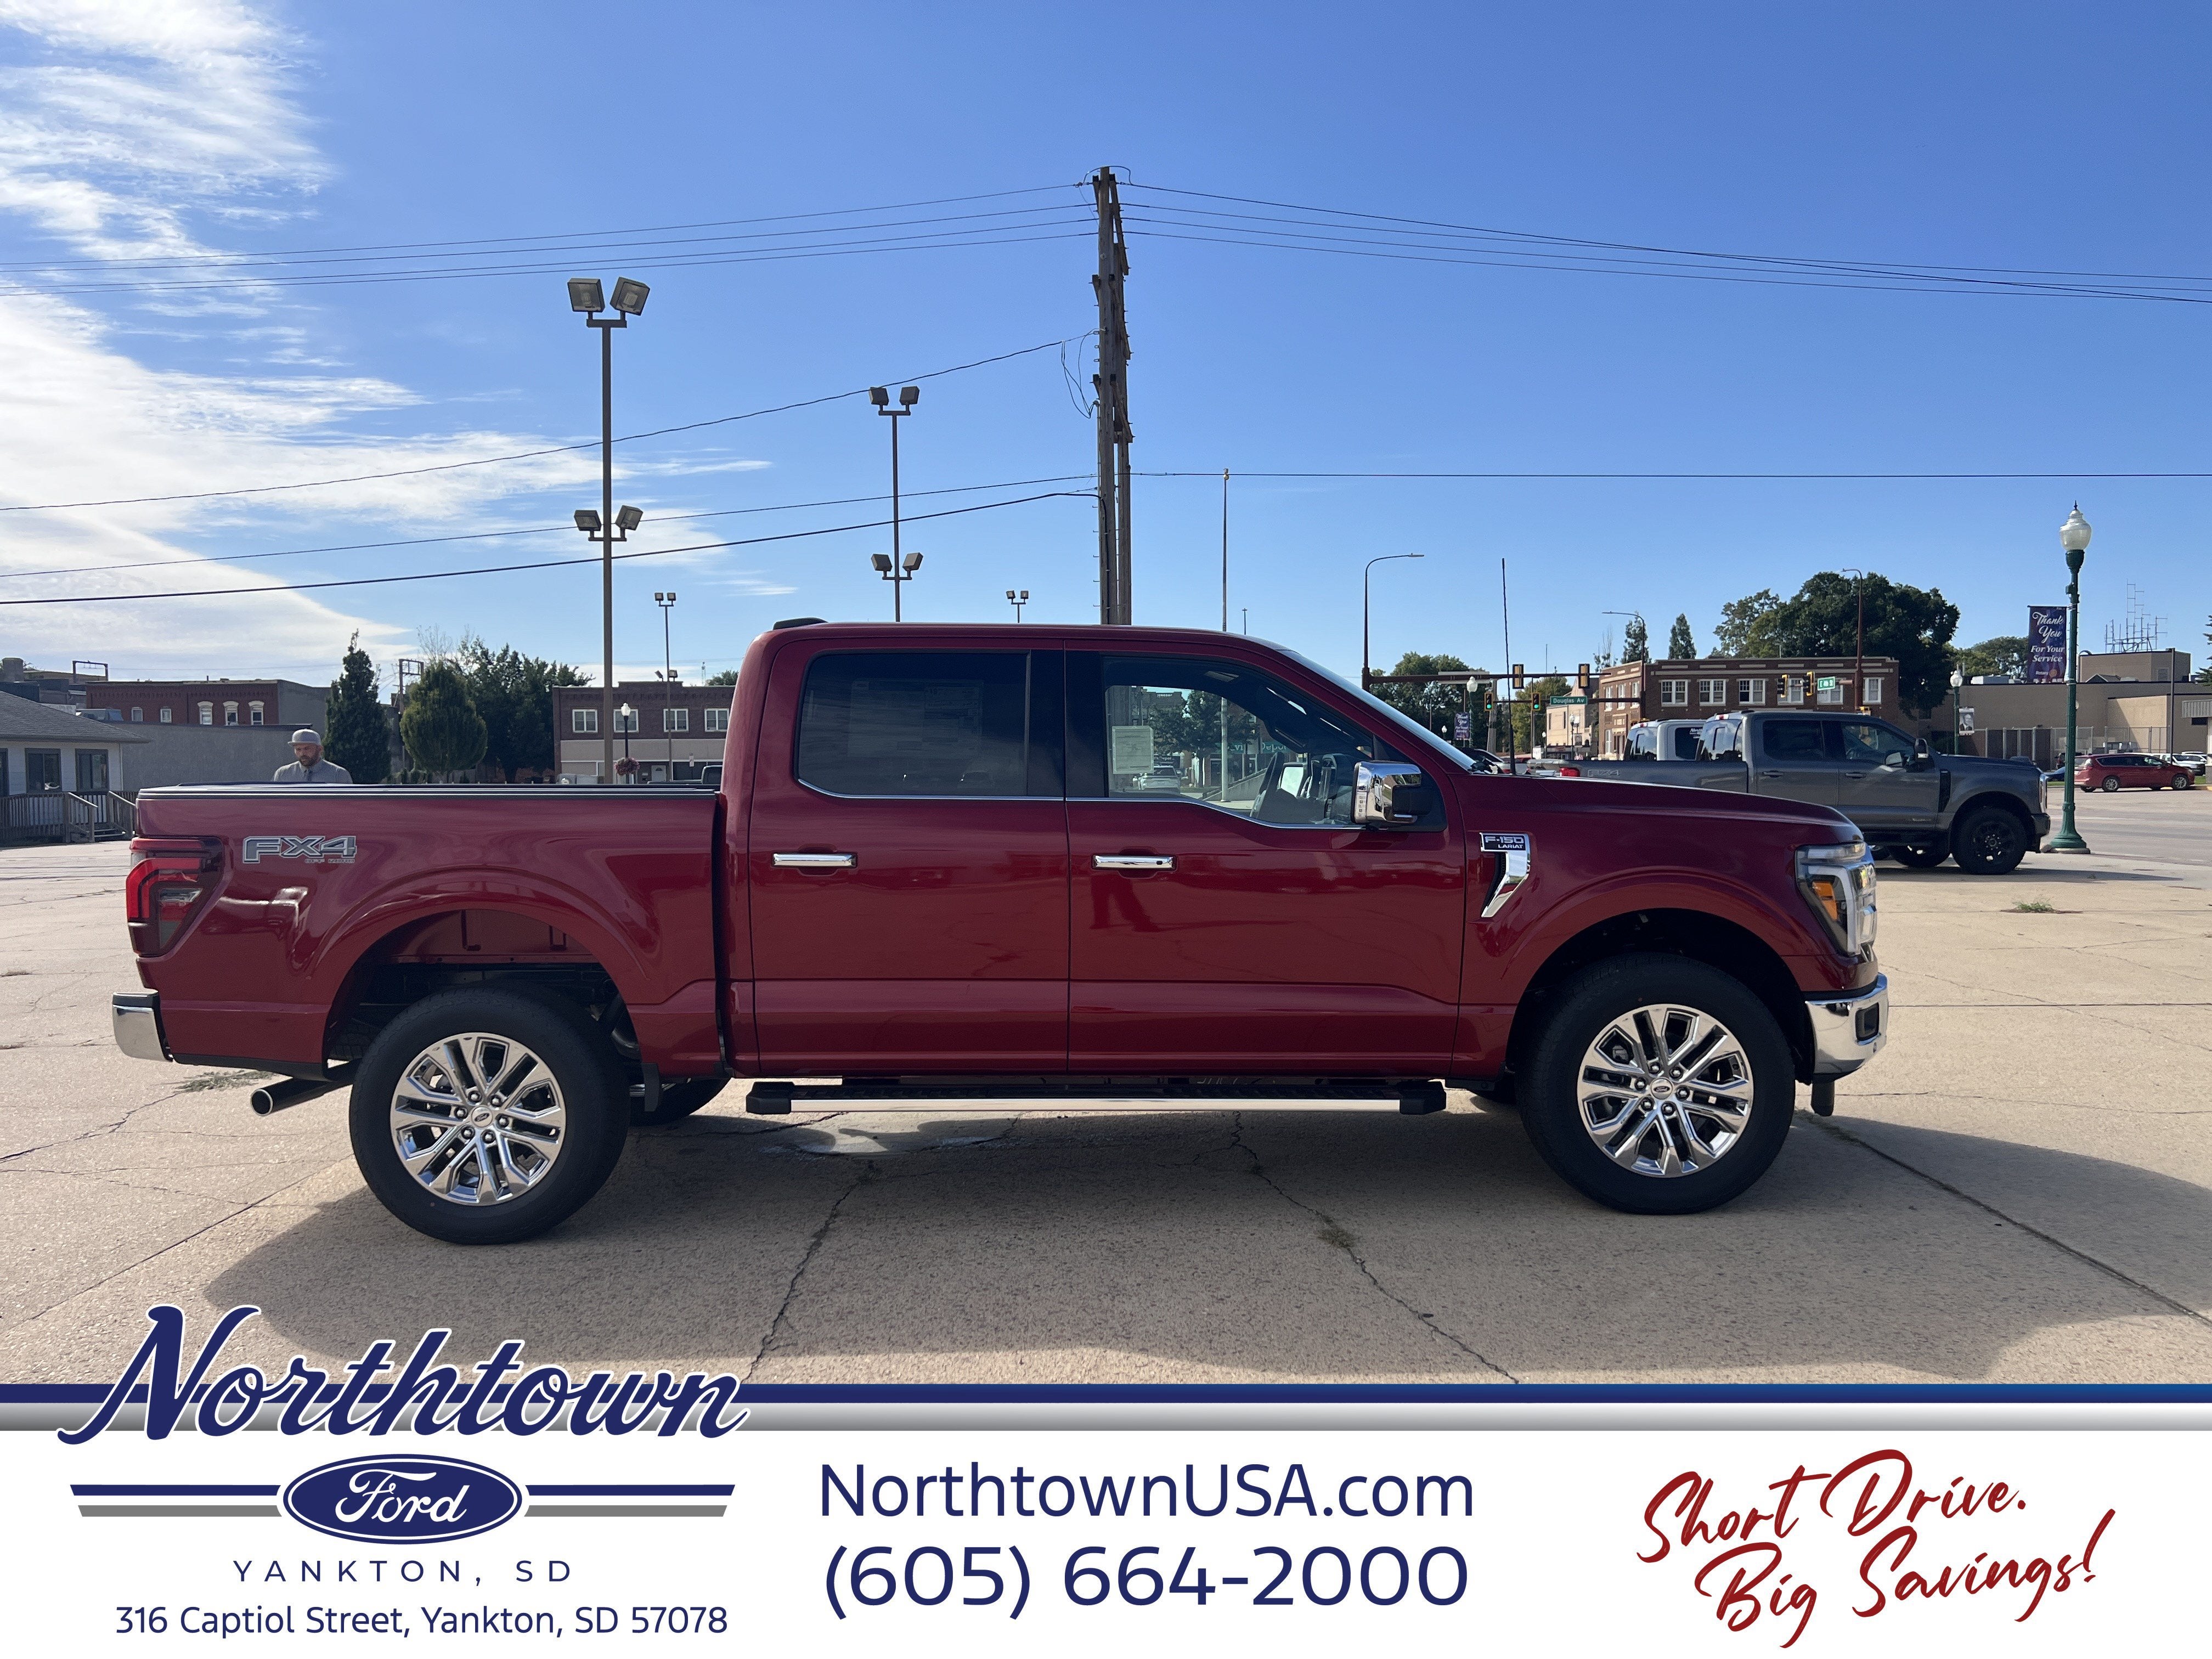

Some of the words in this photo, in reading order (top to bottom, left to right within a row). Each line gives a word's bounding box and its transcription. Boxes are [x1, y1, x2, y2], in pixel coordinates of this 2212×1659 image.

[2032, 612, 2064, 625] Thank
[2038, 625, 2062, 644] You
[243, 836, 357, 864] FX4
